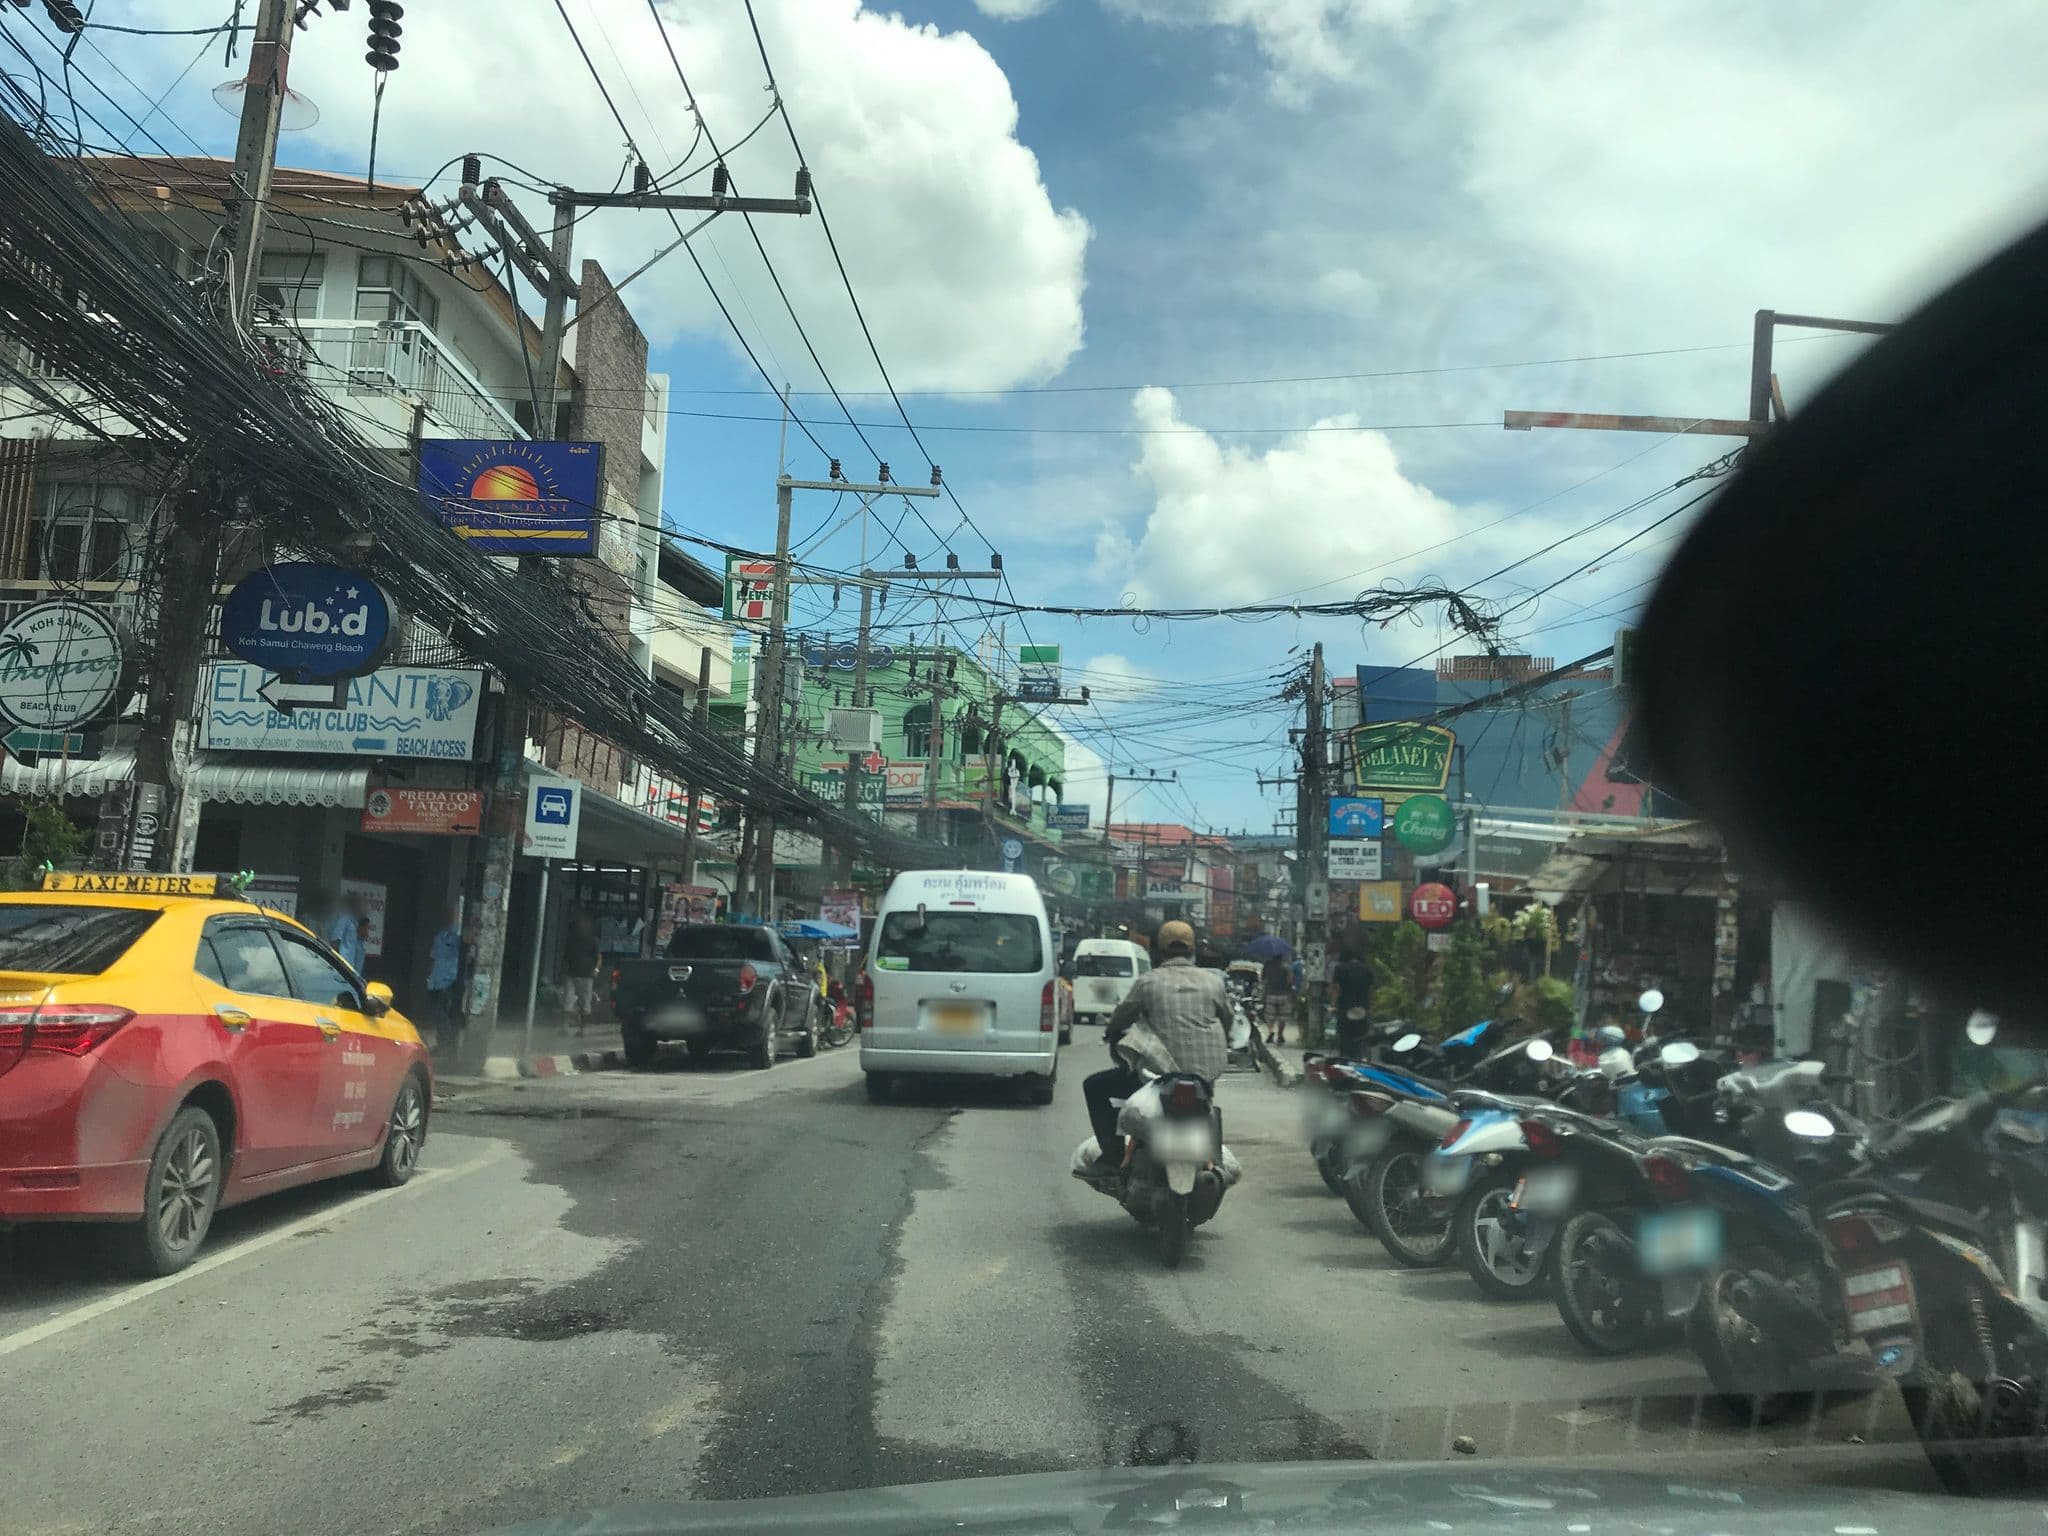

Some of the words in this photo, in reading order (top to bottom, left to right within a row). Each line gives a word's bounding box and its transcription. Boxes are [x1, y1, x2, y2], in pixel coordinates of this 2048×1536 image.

[29, 617, 54, 634] KOH
[57, 617, 94, 637] SAMUI
[238, 637, 257, 646] Koh
[260, 639, 288, 649] Samui
[291, 640, 333, 653] Chaweng
[335, 643, 364, 653] Beach
[20, 701, 51, 712] BEACH
[53, 704, 77, 713] CLUB
[266, 709, 321, 731] BEACH
[325, 711, 368, 732] CLUB
[396, 737, 429, 756] BEACH
[429, 740, 467, 758] ACCESS
[887, 768, 922, 786] bar
[399, 791, 478, 802] PREDATOR
[409, 800, 469, 812] TATTOO
[1401, 820, 1447, 840] Chang
[72, 875, 192, 893] TAXI-METER
